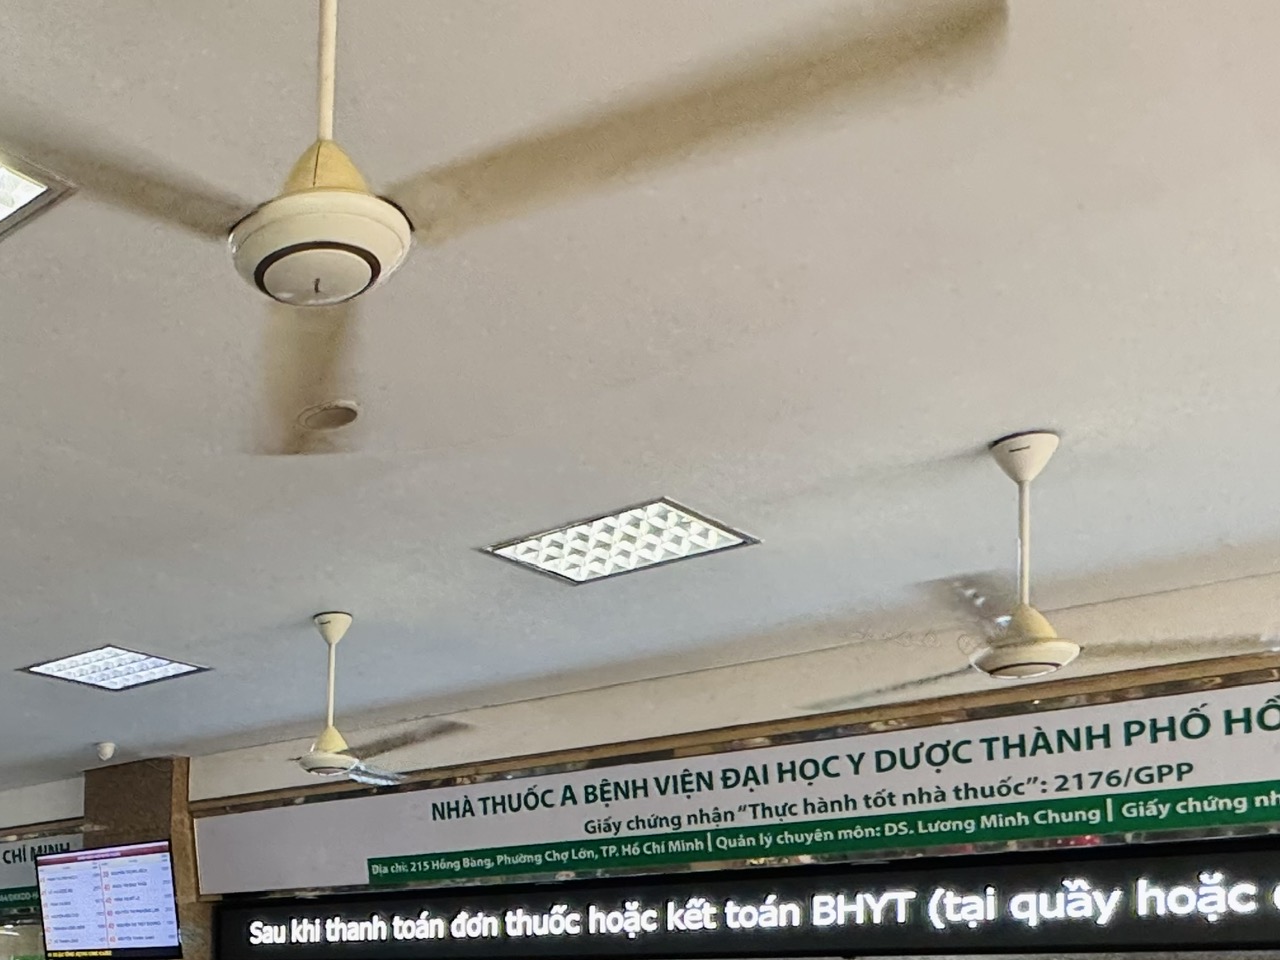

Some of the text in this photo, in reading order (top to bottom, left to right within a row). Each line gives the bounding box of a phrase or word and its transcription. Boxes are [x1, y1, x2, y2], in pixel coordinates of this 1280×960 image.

[431, 694, 1280, 821] NHÀ THUỐC A BỆNH VIỆN ĐẠI HỌC Y DƯỢC THÀNH PHỐ HỒ
[410, 861, 430, 872] 215
[496, 852, 543, 866] Phường
[544, 849, 569, 863] Chợ
[572, 848, 598, 861] Lớn,
[599, 846, 619, 858] TP.
[621, 842, 641, 856] Hồ
[643, 841, 665, 855] Chí
[668, 839, 705, 854] Minh
[716, 835, 757, 849] Quản
[759, 832, 773, 849] lý
[776, 830, 835, 848] chuyên
[837, 824, 881, 840] môn:
[884, 821, 915, 836] DS.
[918, 816, 975, 834] Lương
[980, 811, 1030, 829] Minh
[1033, 807, 1101, 825] Chung
[1121, 798, 1171, 819] Giấy
[1175, 795, 1248, 814] chứng
[584, 815, 622, 836] Giấy
[626, 812, 682, 831] chứng
[687, 806, 735, 828] nhận
[803, 793, 857, 815] hành
[862, 788, 897, 810] tốt
[902, 785, 946, 806] nhà
[1054, 761, 1194, 793] 2176/GPP
[3, 844, 27, 864] CHÍ
[249, 919, 287, 945] Sau
[290, 917, 321, 944] khi
[325, 915, 388, 943] thanh
[391, 910, 445, 941] toán
[450, 910, 499, 939] đơn
[505, 903, 581, 936] thuốc
[588, 900, 658, 939] hoặc
[667, 896, 717, 931] kết
[724, 894, 801, 929] toán
[811, 889, 918, 926] BHYT
[927, 884, 996, 930] (tại
[1010, 877, 1122, 926] quầy
[1135, 869, 1258, 923] hoặc
